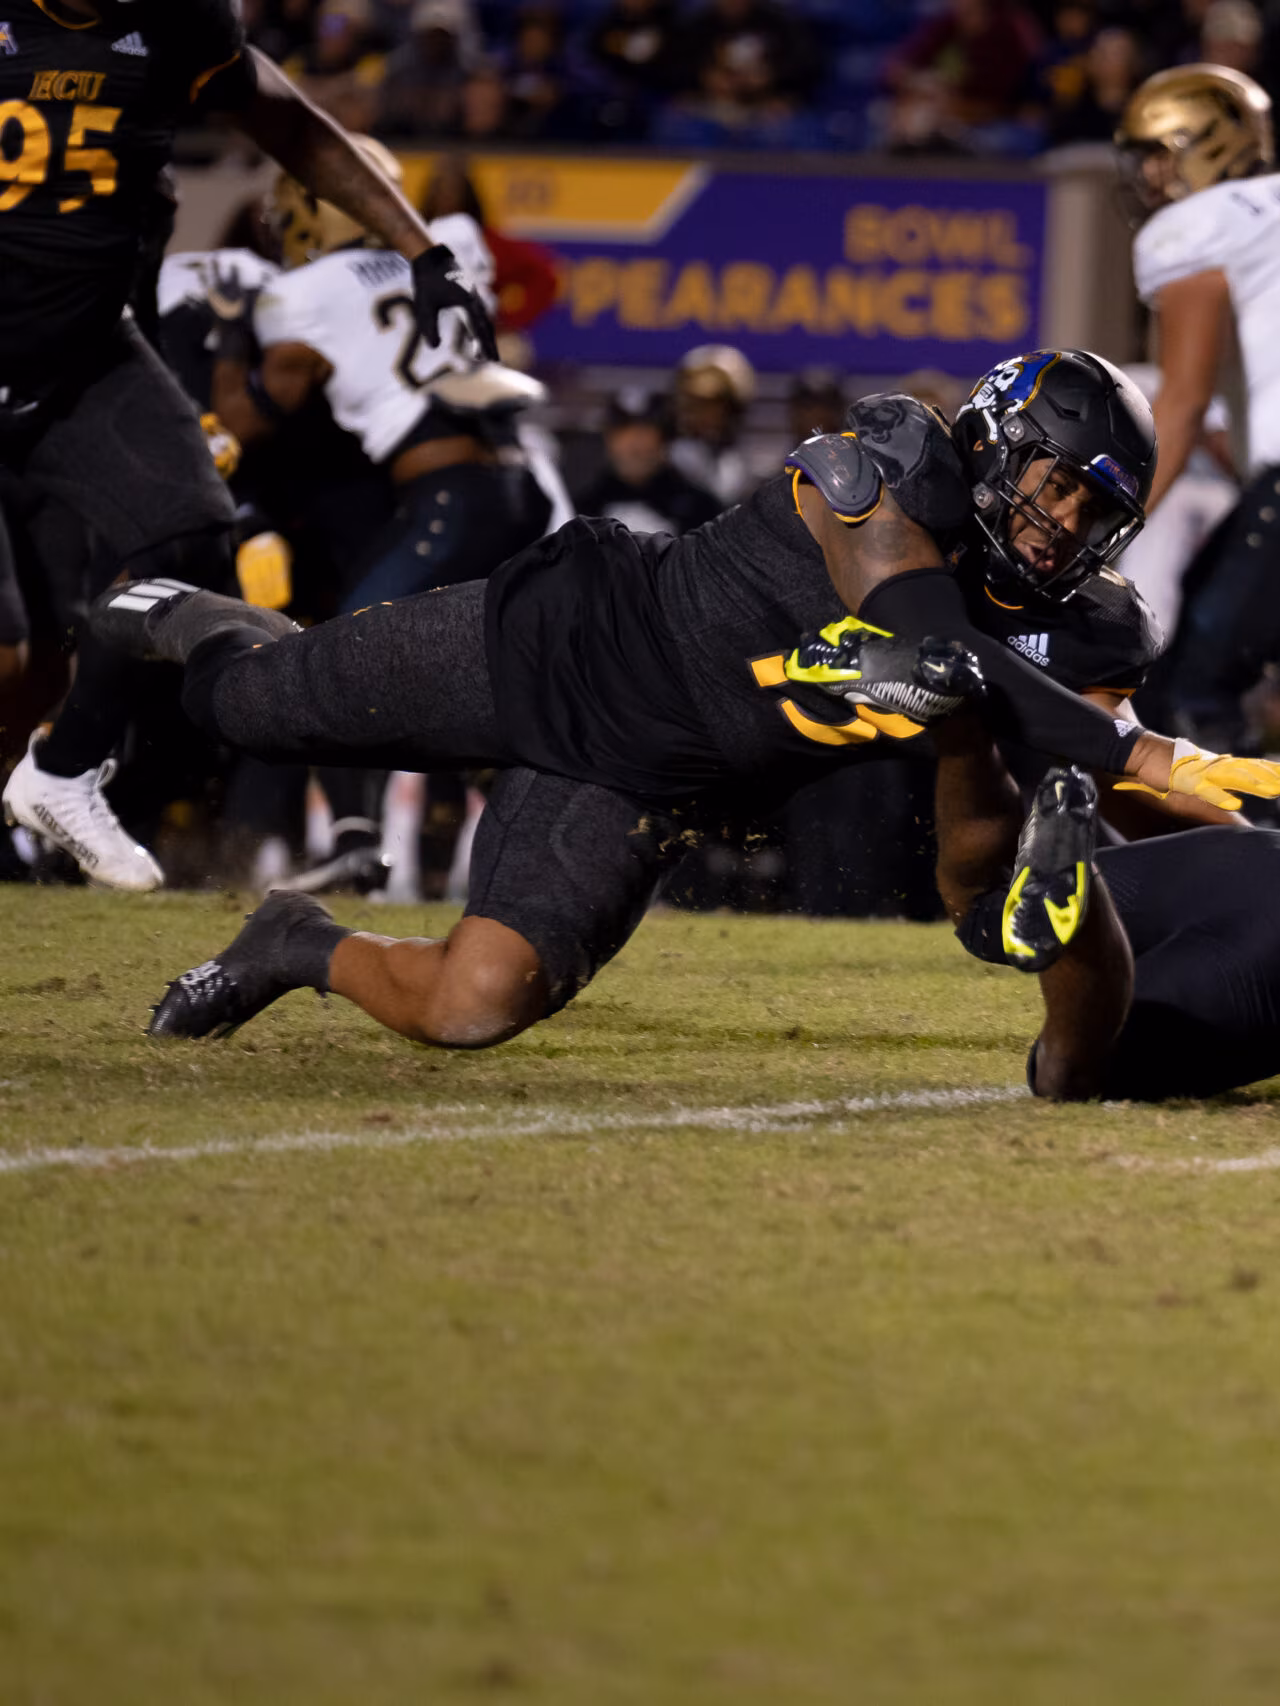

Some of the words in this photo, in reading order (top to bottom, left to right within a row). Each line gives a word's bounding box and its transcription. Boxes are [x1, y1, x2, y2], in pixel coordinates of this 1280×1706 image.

[29, 70, 106, 101] ECU
[0, 98, 122, 214] 95
[844, 203, 1035, 268] BOWL
[557, 256, 1029, 342] PEARANCES
[1007, 635, 1050, 667] adidas
